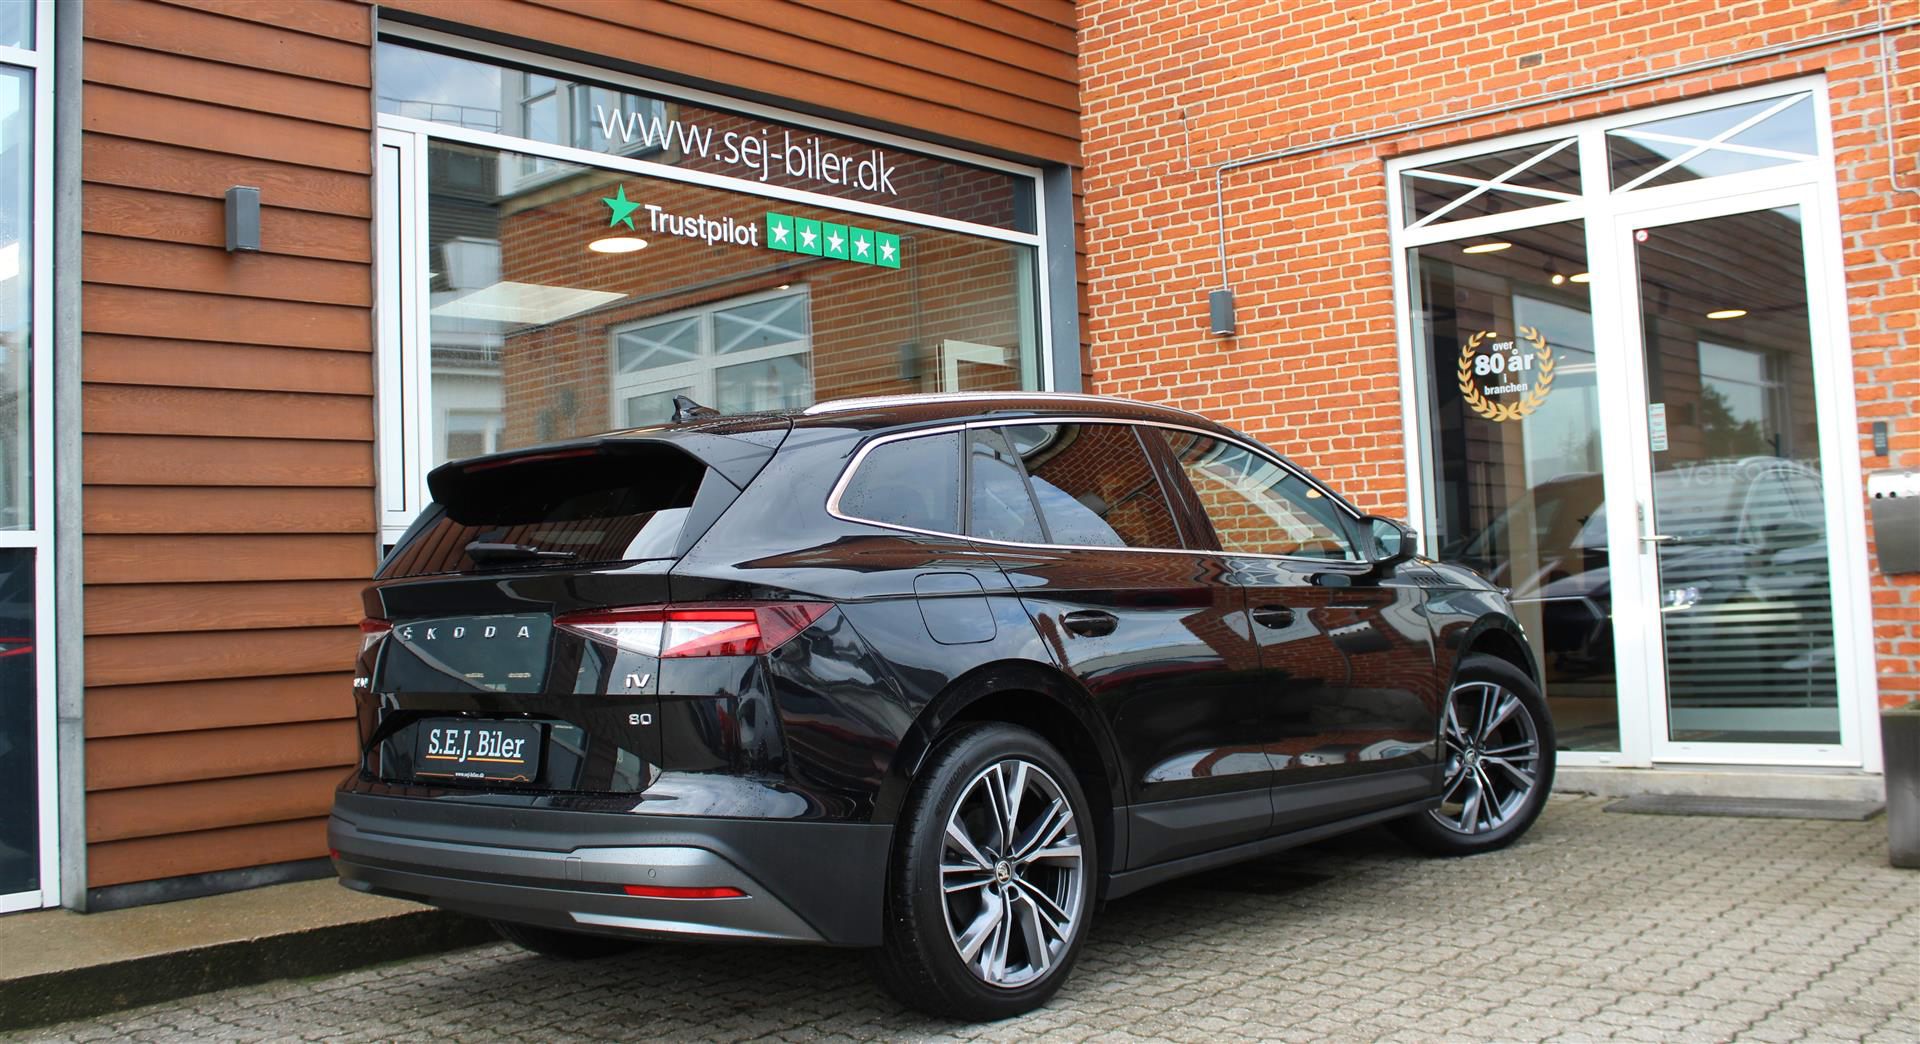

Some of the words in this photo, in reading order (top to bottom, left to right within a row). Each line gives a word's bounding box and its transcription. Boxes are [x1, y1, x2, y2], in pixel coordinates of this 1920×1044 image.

[597, 104, 898, 195] www.sej-biler.dk
[644, 204, 759, 247] Trustpilot
[1492, 341, 1514, 351] over
[1474, 352, 1505, 376] 80
[1507, 348, 1534, 372] år
[1483, 382, 1528, 396] branchen
[628, 713, 652, 725] 80
[428, 728, 472, 762] S.E.J.
[476, 730, 525, 758] Biler
